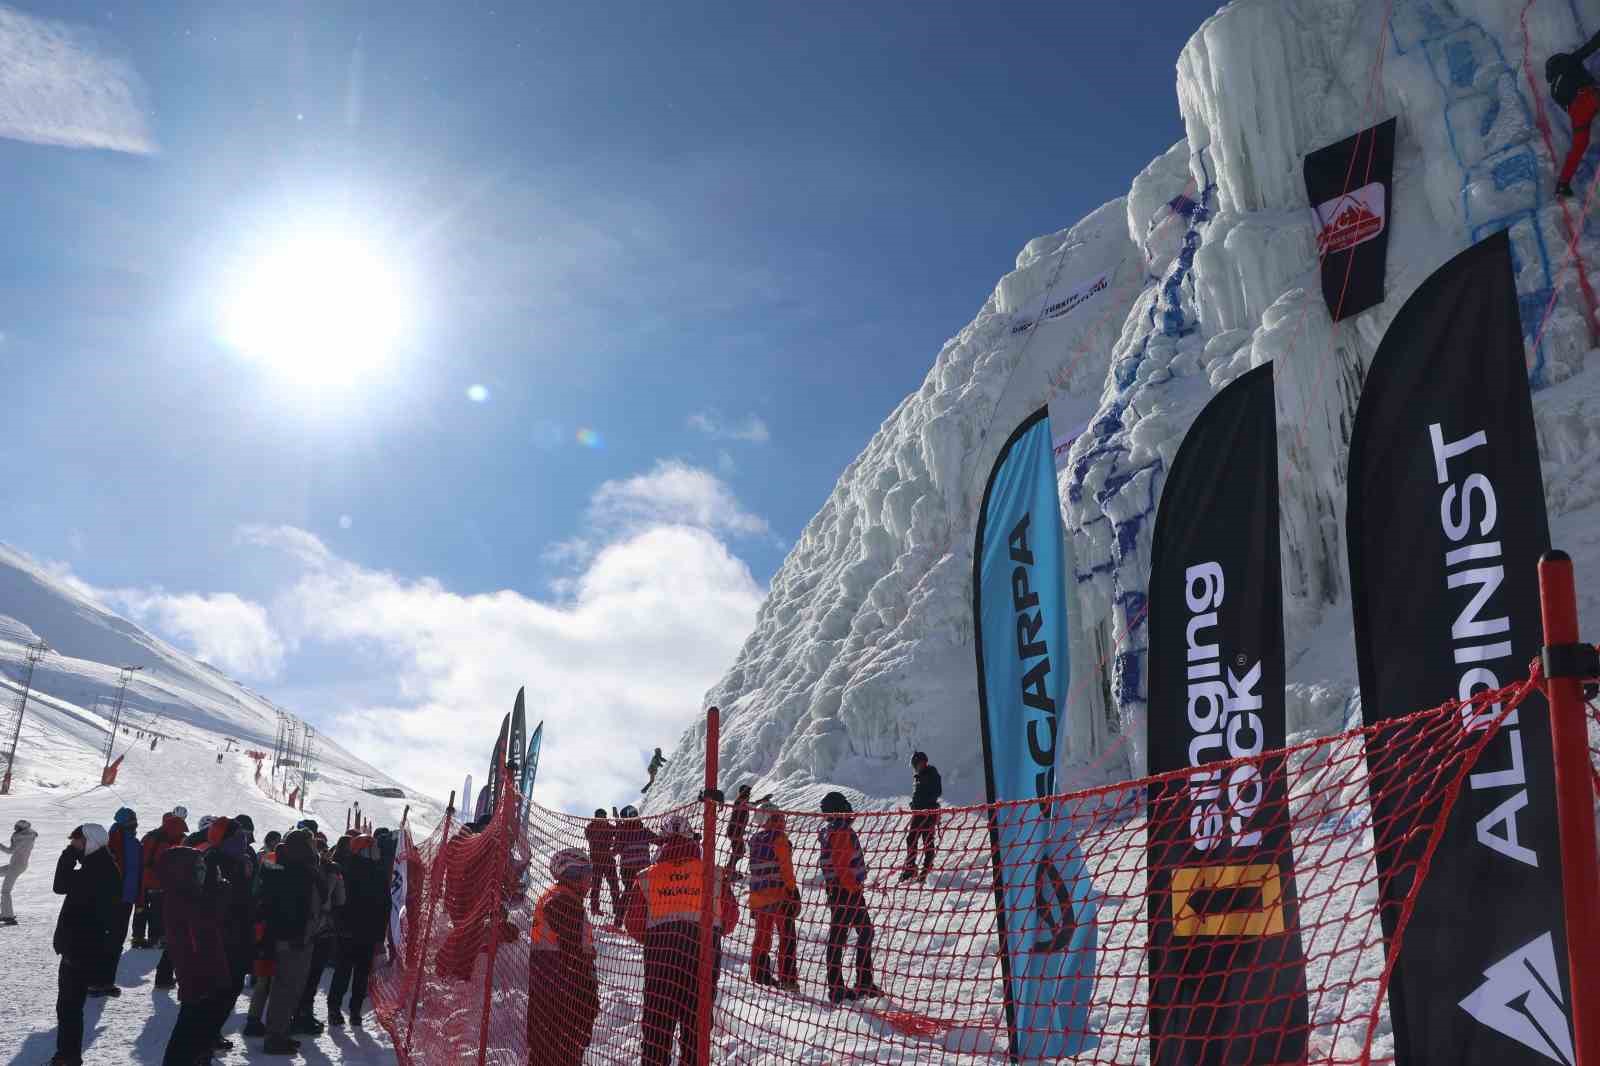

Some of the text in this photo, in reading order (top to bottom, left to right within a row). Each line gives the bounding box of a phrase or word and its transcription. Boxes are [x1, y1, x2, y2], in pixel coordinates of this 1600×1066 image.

[1185, 561, 1230, 851] singing
[1225, 659, 1264, 848] rock
[1428, 422, 1539, 868] ALPINIST
